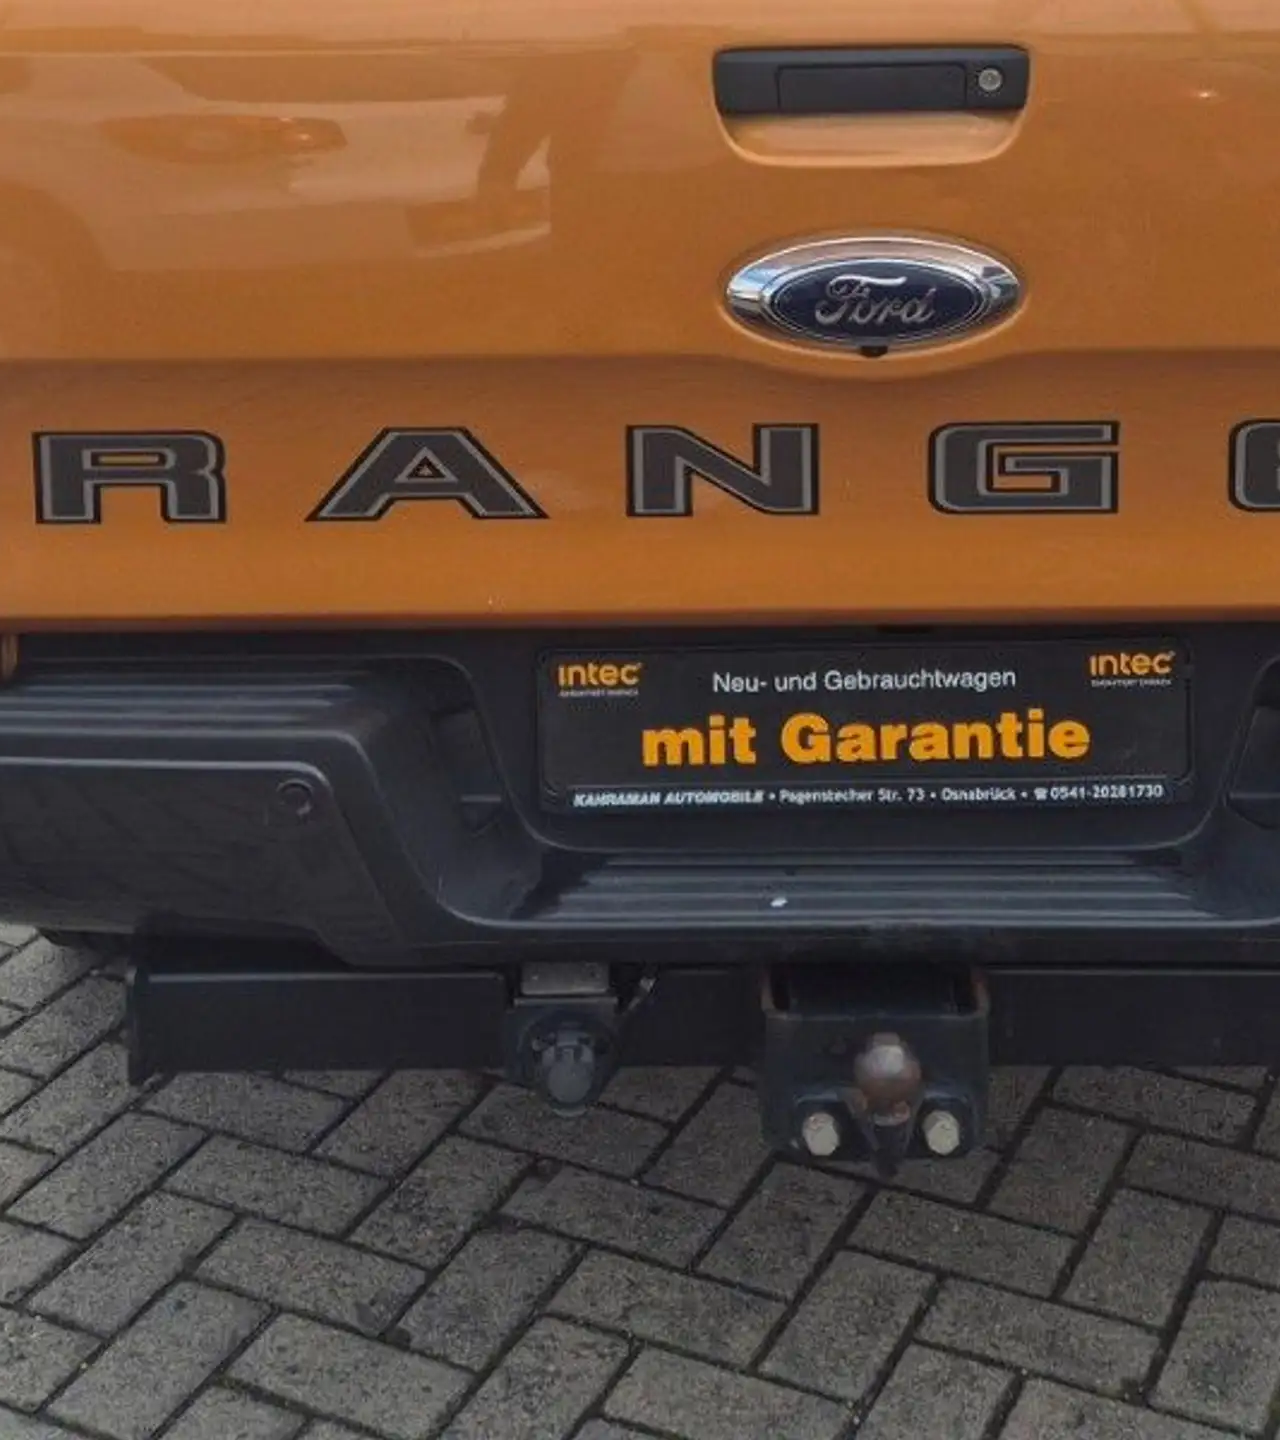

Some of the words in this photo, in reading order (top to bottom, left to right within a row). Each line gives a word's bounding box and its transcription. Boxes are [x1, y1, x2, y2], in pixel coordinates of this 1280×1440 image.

[814, 273, 938, 326] Ford
[558, 662, 640, 687] intec
[1090, 651, 1174, 676] intec
[712, 671, 767, 694] Neu-
[774, 670, 817, 692] und
[823, 667, 1017, 693] Gebrauchtwagen
[642, 713, 757, 767] mit
[780, 706, 1092, 765] Garantie
[663, 788, 765, 806] AUTOMOBILE
[778, 786, 874, 805] Pagenstecher
[877, 786, 902, 803] Str.
[906, 786, 926, 802] 73
[940, 785, 1017, 802] Osnabrück
